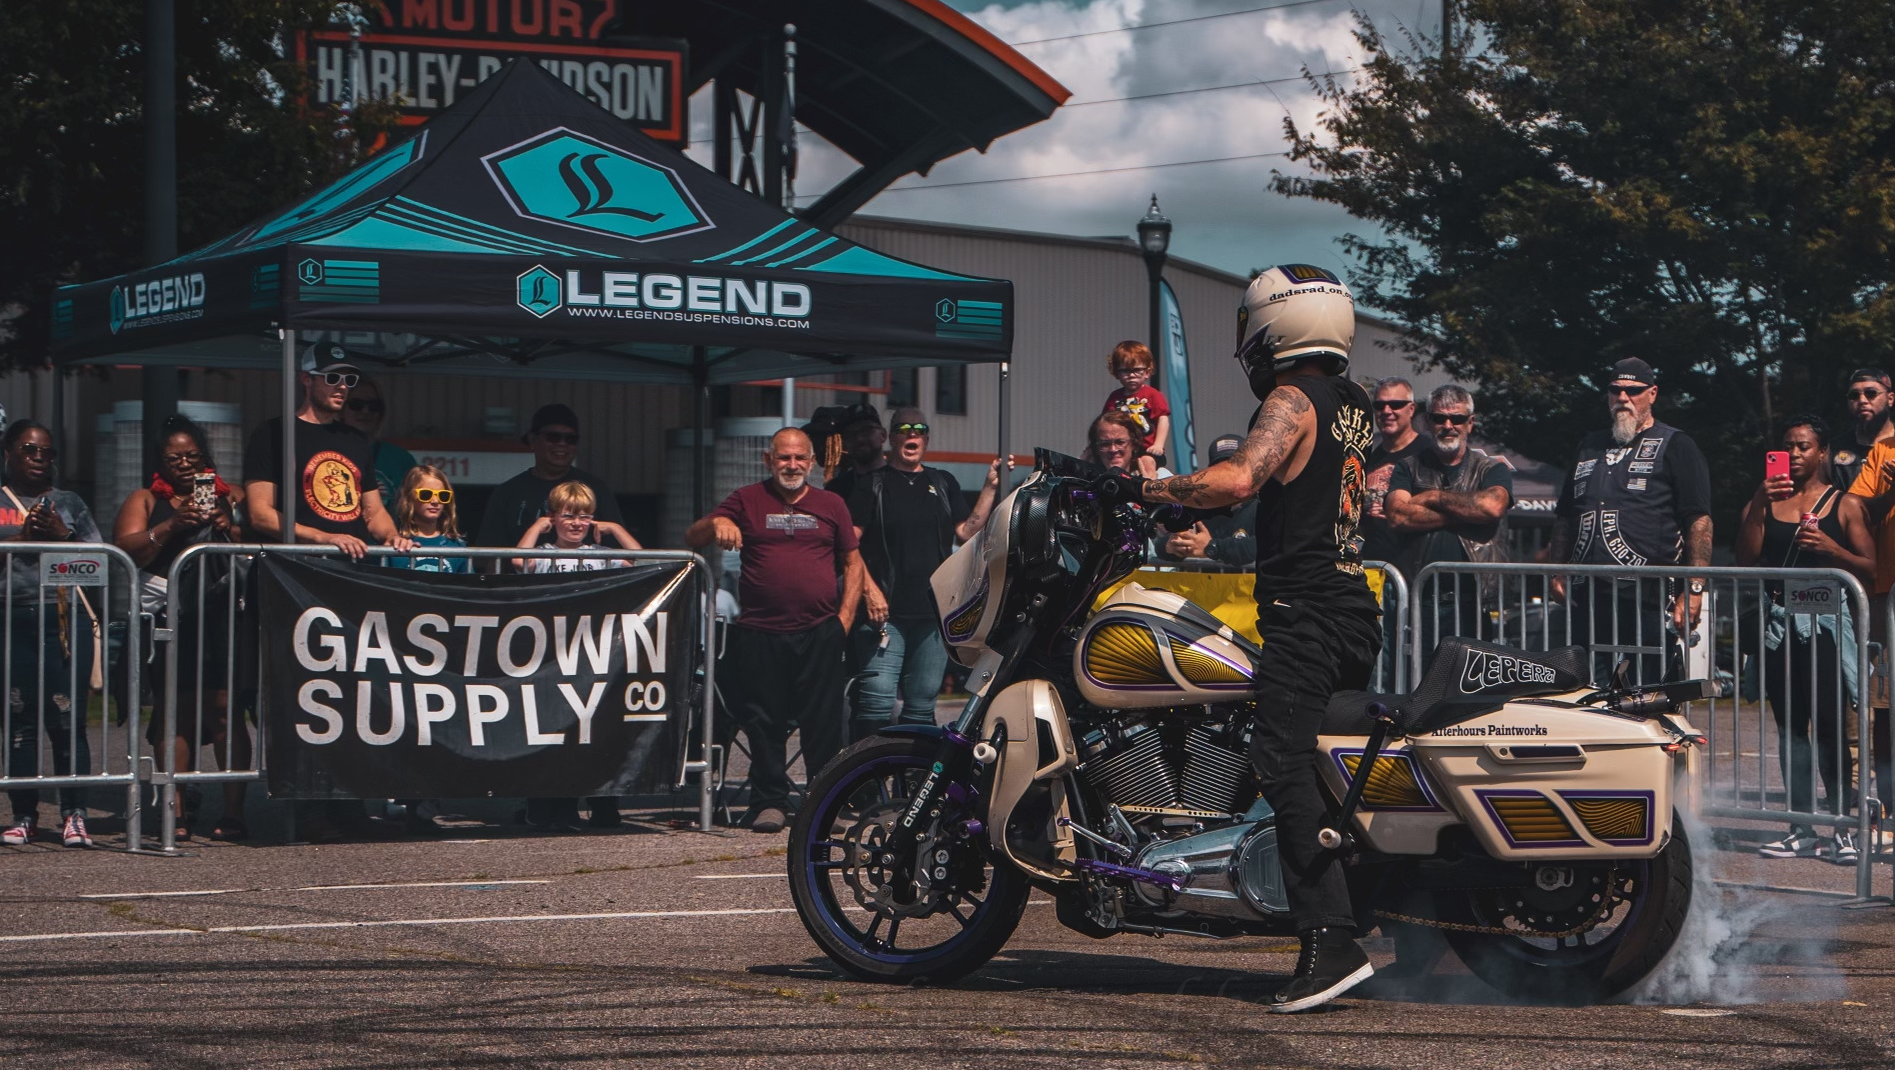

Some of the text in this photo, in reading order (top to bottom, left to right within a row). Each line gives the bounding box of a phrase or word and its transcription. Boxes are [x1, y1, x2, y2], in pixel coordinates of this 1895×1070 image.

[124, 271, 206, 318] LEGEND
[566, 269, 813, 318] LEGEND
[567, 307, 811, 329] WWW.LEGENDSUSPENSIONS.COM
[49, 563, 97, 574] SONCO
[1791, 590, 1829, 602] SONCO
[293, 606, 668, 678] GASTOWN
[295, 679, 667, 746] SUPPLY CO
[1487, 724, 1548, 736] Paintworks
[903, 772, 939, 828] LEGEND
